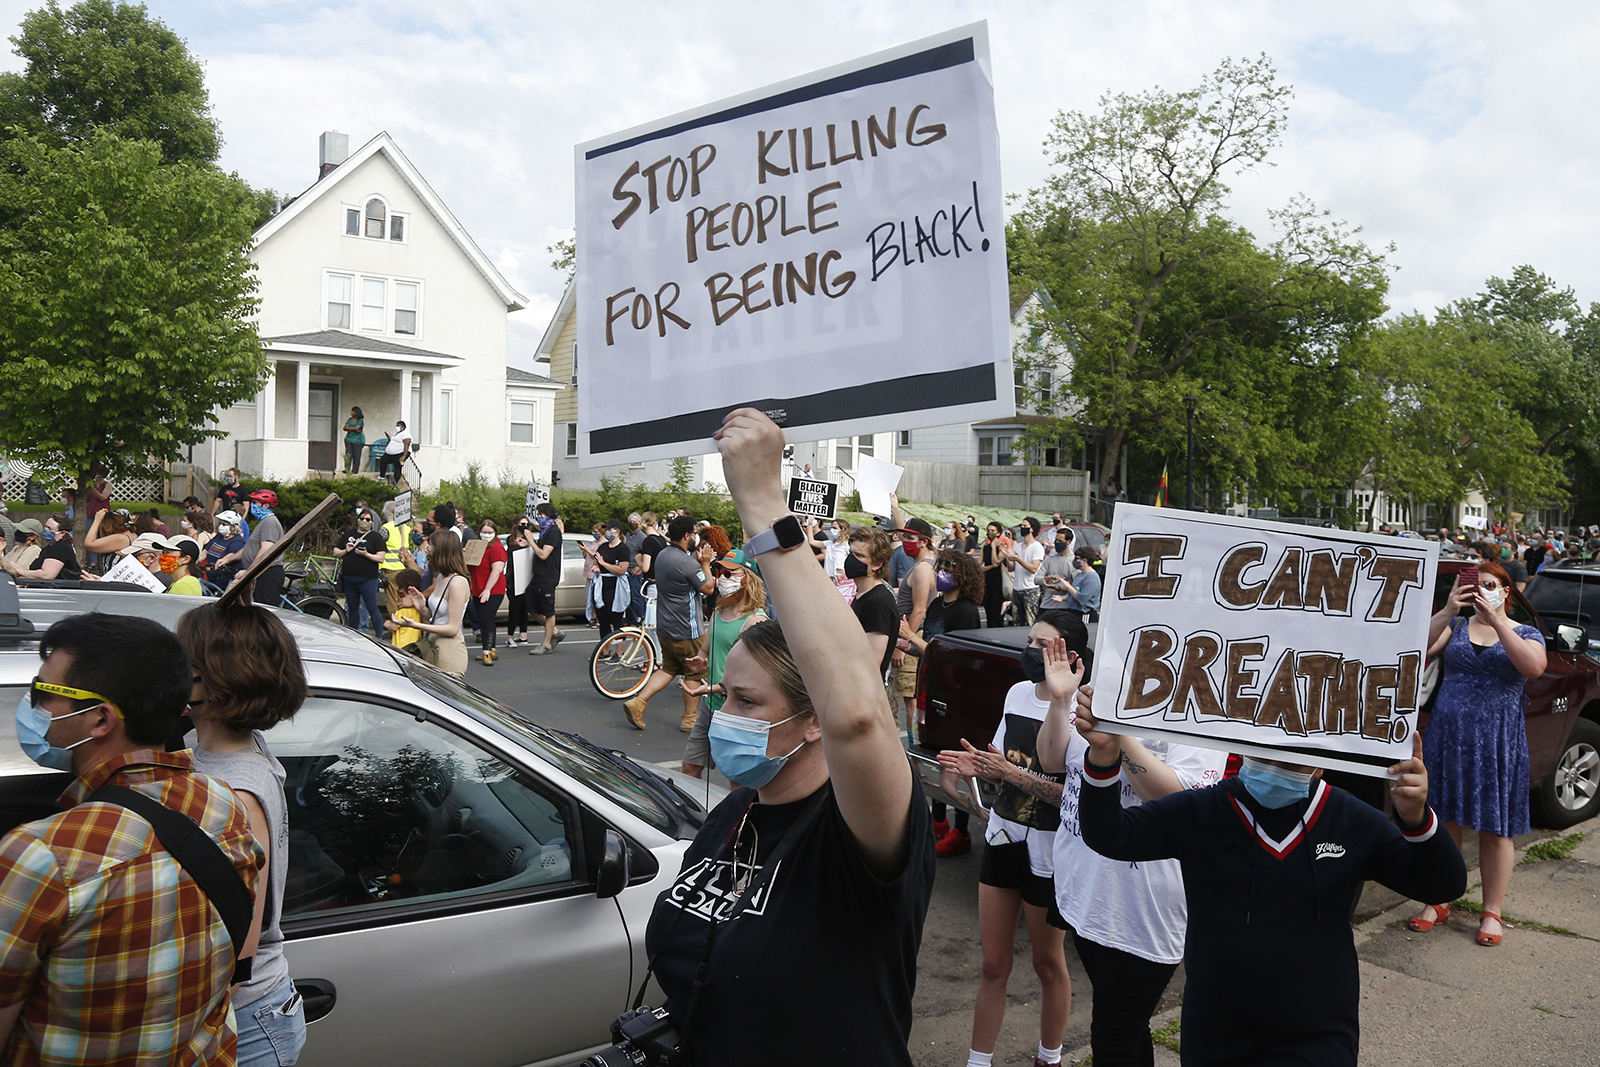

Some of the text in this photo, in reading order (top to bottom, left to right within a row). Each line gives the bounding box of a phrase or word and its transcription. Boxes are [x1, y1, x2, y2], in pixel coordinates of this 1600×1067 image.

[611, 144, 717, 230] STOP
[757, 104, 947, 184] KILLING
[605, 181, 991, 347] FOR BEING BLACK!
[685, 181, 843, 264] PEOPLE
[795, 502, 827, 514] MATTER
[800, 481, 827, 494] BLACK
[801, 492, 824, 504] LIVES
[113, 565, 130, 579] BLACK
[1118, 532, 1425, 623] I CAN'T
[1115, 624, 1421, 743] BREATHE!
